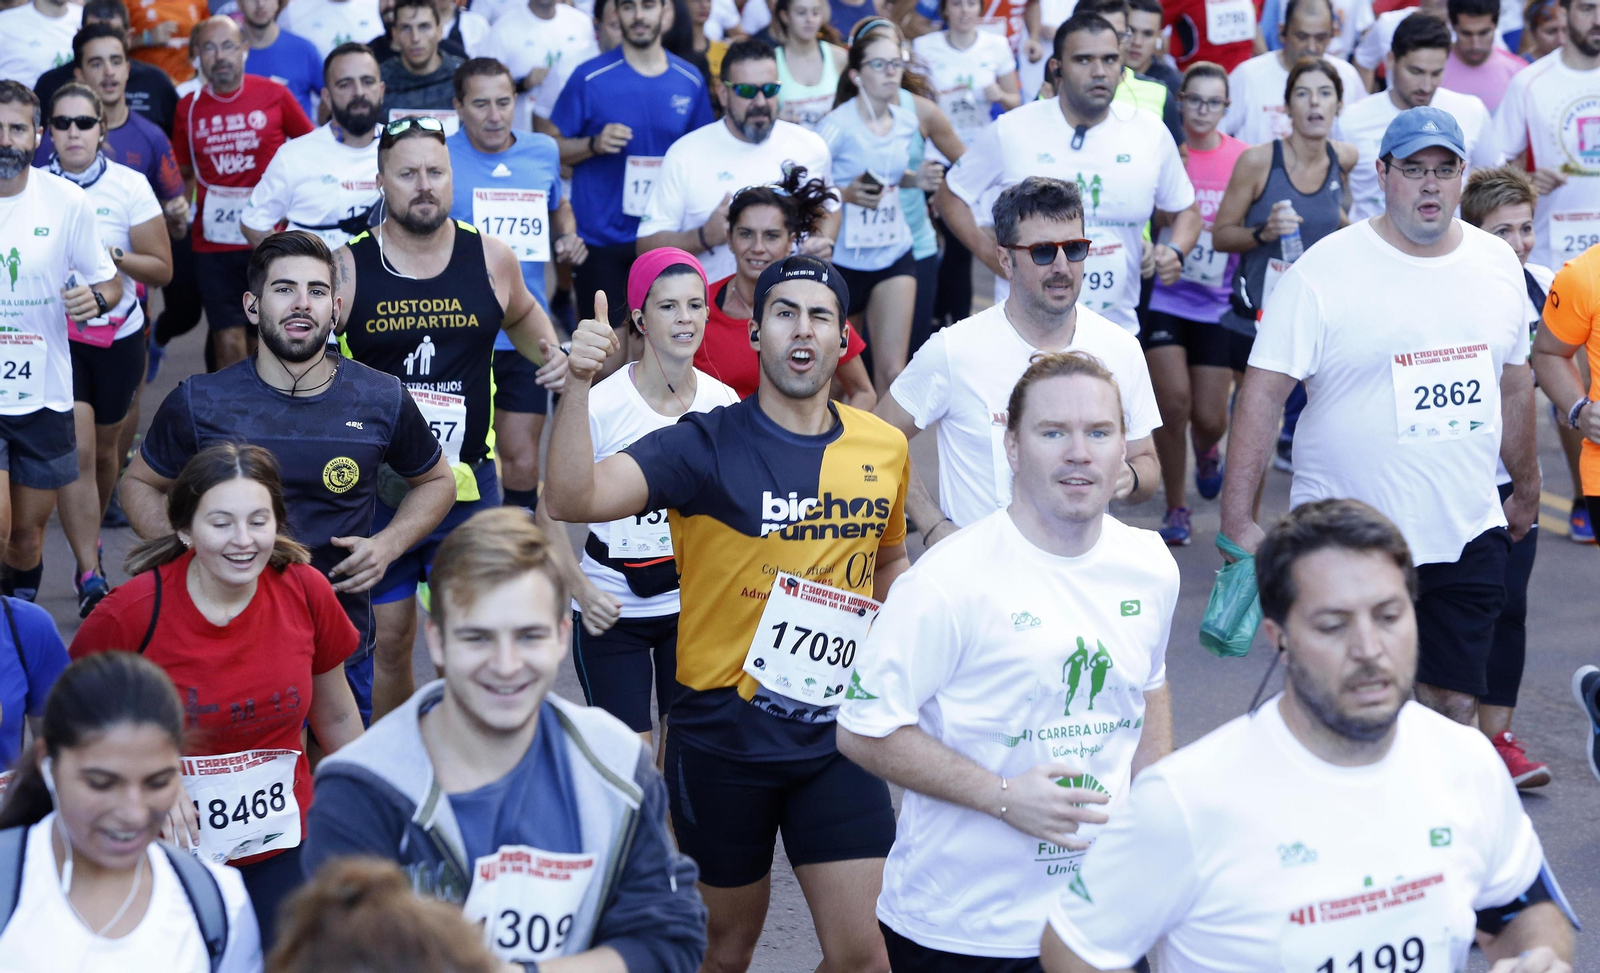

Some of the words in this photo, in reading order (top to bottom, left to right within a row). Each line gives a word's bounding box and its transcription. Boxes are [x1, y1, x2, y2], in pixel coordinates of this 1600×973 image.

[215, 208, 243, 223] 24
[482, 216, 542, 236] 17759
[1083, 271, 1114, 290] 93
[376, 298, 462, 316] CUSTODIA
[366, 313, 479, 333] COMPARTIDA
[1413, 348, 1455, 359] CARRERA
[1456, 343, 1489, 354] URBANA
[437, 380, 462, 392] HIJOS
[1414, 379, 1482, 410] 2862
[762, 491, 890, 522] bichos
[761, 522, 887, 540] runners
[802, 584, 847, 605] CARRERA
[848, 595, 880, 613] URBANA
[772, 621, 857, 668] 17030
[1038, 724, 1092, 741] CARRERA
[197, 753, 250, 769] CARRERA
[198, 766, 232, 776] CIUDAD
[234, 764, 244, 773] DE
[481, 909, 574, 954] 309
